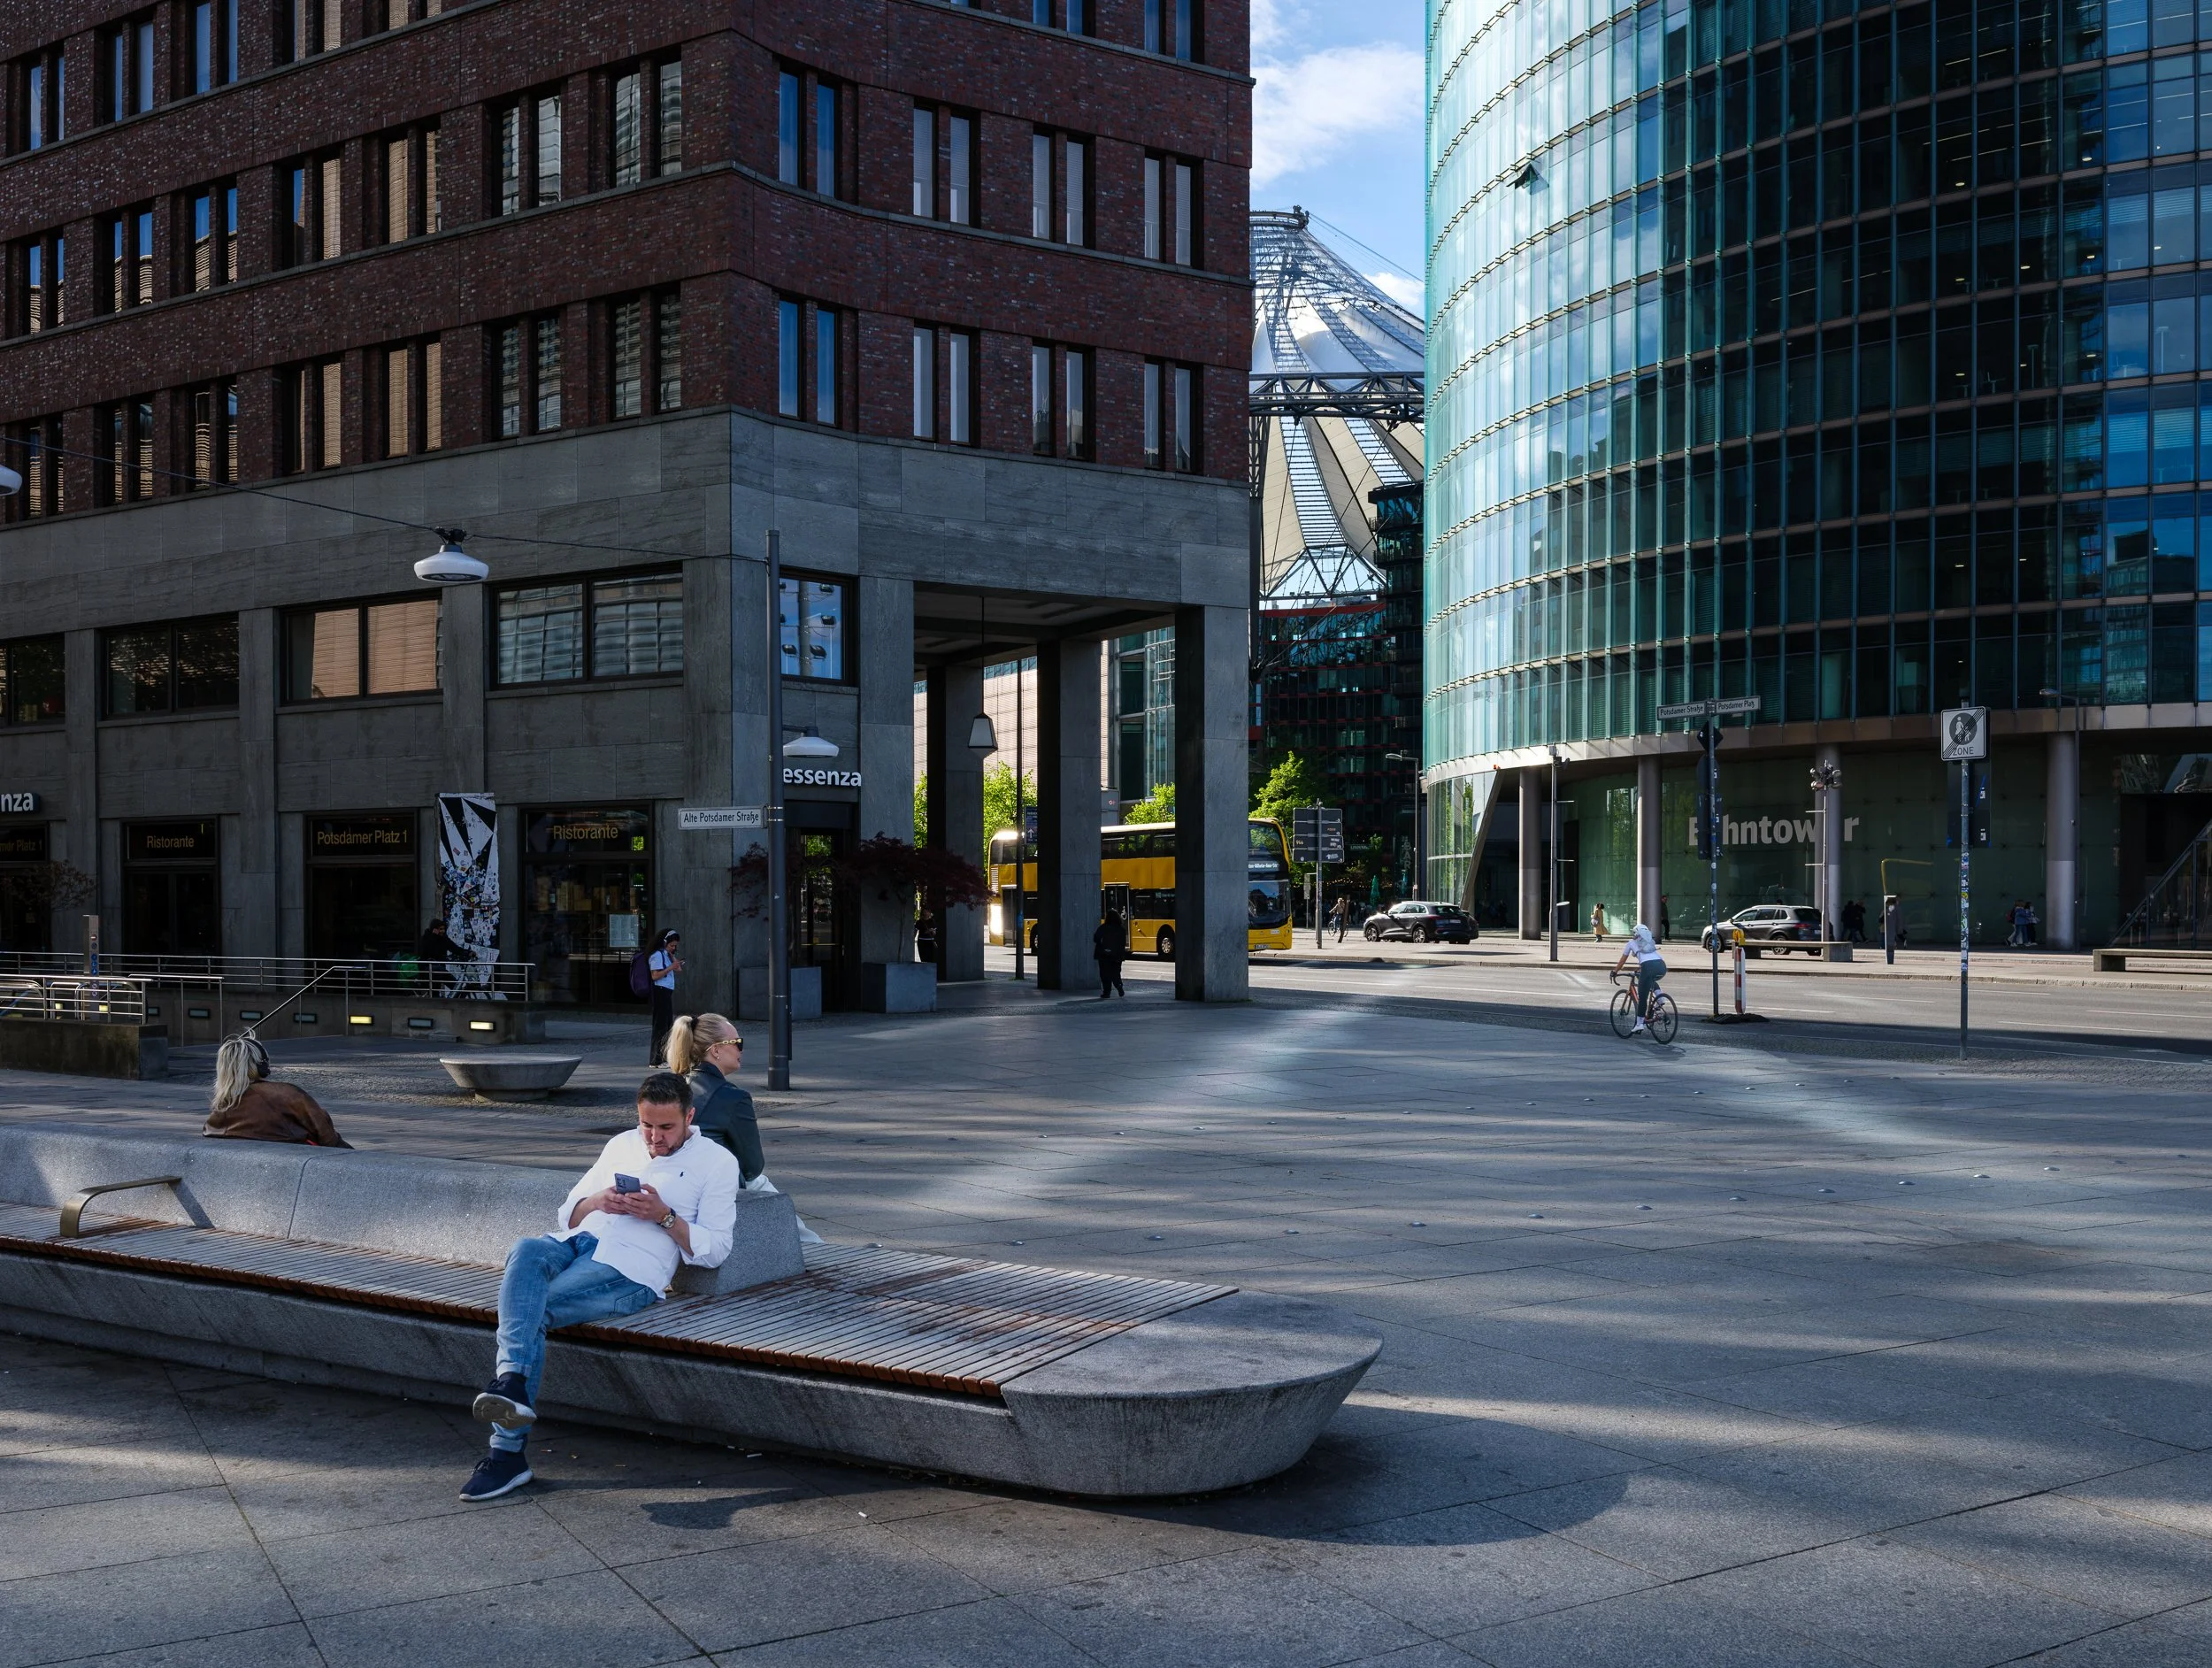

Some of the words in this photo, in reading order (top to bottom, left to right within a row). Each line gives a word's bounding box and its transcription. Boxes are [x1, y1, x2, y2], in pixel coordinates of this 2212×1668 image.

[1953, 747, 1974, 756] ZONE
[783, 768, 862, 787] essenza
[1, 792, 34, 812] nza
[684, 813, 698, 823] Alte
[699, 812, 734, 823] Potsdamer
[736, 811, 759, 824] Straße
[317, 831, 373, 845] Potsdamer
[374, 829, 401, 843] Platz
[403, 829, 409, 843] 1
[553, 825, 618, 840] Ristorante
[1689, 814, 1859, 846] hntowr
[146, 834, 195, 849] Ristorante
